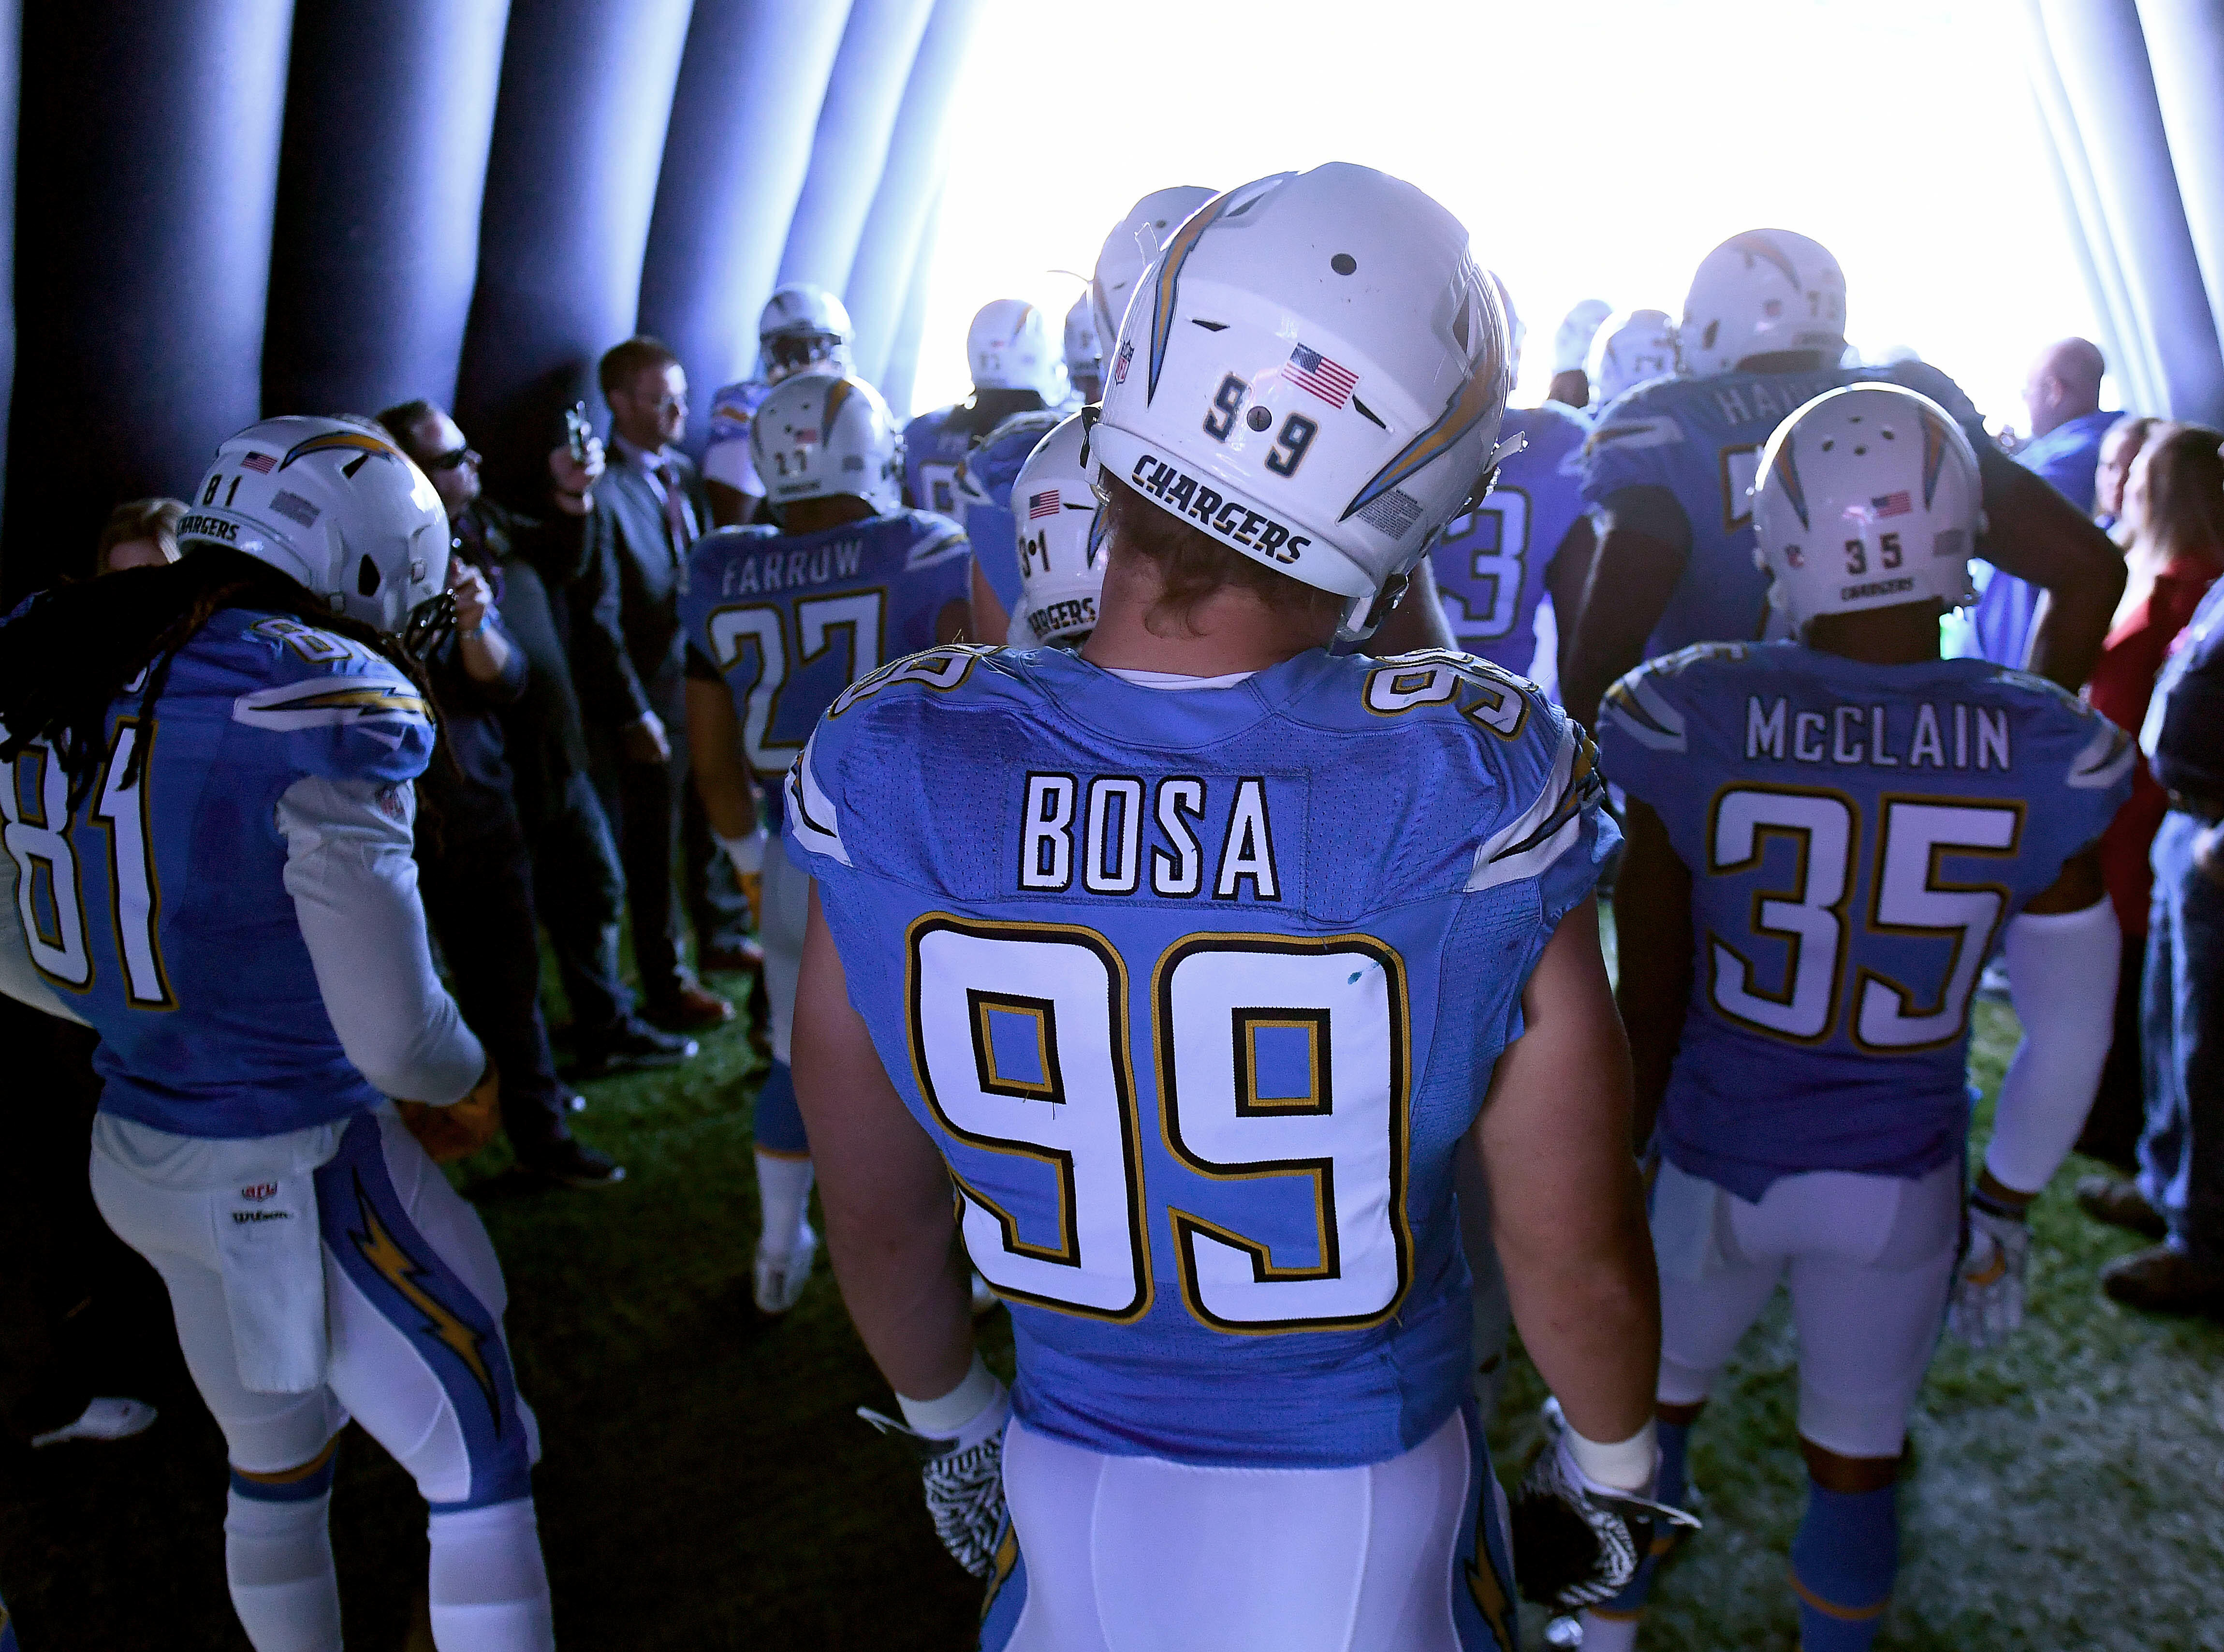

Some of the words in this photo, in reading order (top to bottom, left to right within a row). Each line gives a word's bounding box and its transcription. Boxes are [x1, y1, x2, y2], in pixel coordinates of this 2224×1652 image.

[1202, 370, 1320, 479] 99
[202, 474, 242, 506] 81
[1131, 454, 1312, 564] CHARGERS
[1844, 532, 1902, 575] 35
[706, 586, 888, 777] 27
[1744, 694, 2010, 770] McCLAIN
[0, 715, 180, 1011] 81
[1018, 771, 1282, 902] BOSA
[1707, 781, 2027, 1055] 35
[904, 911, 1414, 1335] 99
